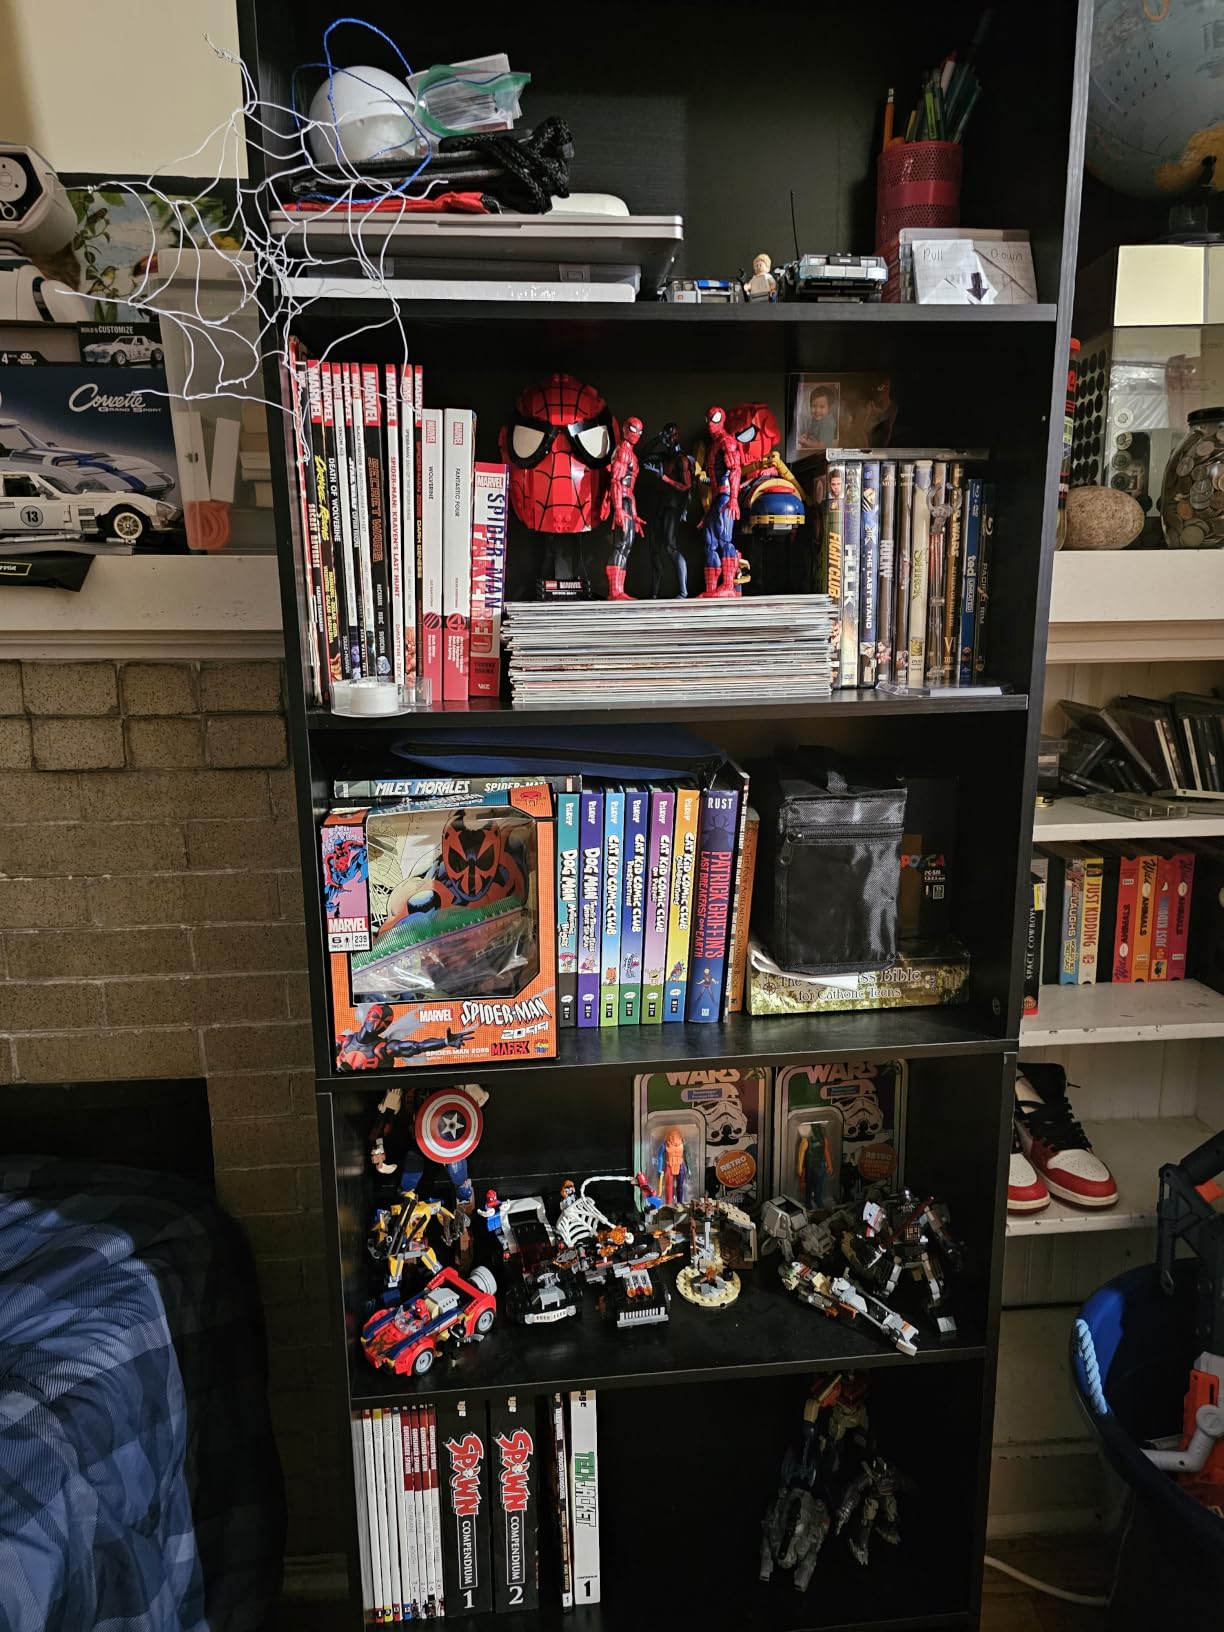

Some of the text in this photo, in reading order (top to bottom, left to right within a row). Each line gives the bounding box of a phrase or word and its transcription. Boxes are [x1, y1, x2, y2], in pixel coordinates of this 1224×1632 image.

[922, 248, 943, 261] Pull
[98, 326, 133, 334] CUSTOMIZE
[69, 383, 146, 412] Corvette
[308, 367, 321, 418] MARVEL
[322, 373, 333, 421] MARVEL
[364, 373, 378, 423] MARVEL
[386, 374, 397, 421] MARVEL
[427, 421, 435, 443] MARVEL
[454, 422, 463, 445] MARVEL
[367, 457, 381, 517] SECRET
[390, 457, 398, 509] SPIDER-MAN:
[476, 476, 504, 489] MARVEL
[328, 458, 340, 542] DEATH OF WOLVERINE
[26, 511, 39, 522] 13
[391, 512, 399, 550] KRAVEN'S
[951, 522, 961, 557] WARS
[471, 523, 495, 594] FAKE
[485, 493, 505, 609] SPIDER-MAN
[880, 540, 894, 578] ROCKY
[828, 532, 841, 598] FIGHT CLUB
[843, 544, 858, 608] HULK
[912, 550, 929, 600] SHREK
[966, 555, 977, 612] ted UNRATED
[979, 563, 988, 602] PACIFIC
[470, 599, 494, 653] RED
[375, 782, 412, 795] MILES
[415, 781, 470, 795] MORALES
[707, 797, 733, 810] RUST
[608, 834, 619, 855] CAT
[634, 834, 645, 855] CAT
[660, 835, 670, 855] CAT
[685, 832, 695, 852] CAT
[561, 849, 578, 874] DOG
[584, 848, 600, 873] DOG
[561, 876, 578, 901] MAN
[583, 875, 599, 900] MAN
[1139, 859, 1157, 936] Wild ANIMALS
[695, 851, 711, 957] LAST BREAKFAST ON EARTH
[705, 851, 732, 958] PATRICK GRIFFIN'S
[1067, 897, 1078, 937] LAUGHS
[1083, 882, 1101, 947] JUST KIDDING
[328, 918, 368, 932] MARVEL
[606, 909, 617, 935] CLUB
[632, 908, 641, 933] CLUB
[656, 909, 665, 933] CLUB
[679, 905, 689, 930] CLUB
[1155, 896, 1169, 947] JUST KIDDI
[734, 930, 744, 968] COMPANION
[1026, 908, 1036, 980] SPACE COWBOYS
[780, 977, 801, 987] The
[881, 968, 921, 983] Bible
[799, 989, 815, 1001] for
[868, 987, 901, 998] Teens
[419, 1009, 452, 1022] MARVEL
[460, 997, 551, 1026] SPIDER-MAN
[501, 1021, 548, 1040] 2099
[426, 1048, 469, 1057] SPIDER-MAN
[491, 1040, 530, 1056] MAFEX
[665, 1068, 740, 1086] WARS
[805, 1063, 877, 1084] WARS
[720, 1155, 746, 1171] RETRO
[865, 1152, 892, 1160] RETRO
[403, 1426, 411, 1456] GUNSLINGER
[493, 1428, 533, 1512] SPAWN
[575, 1452, 597, 1528] TECH JACKET
[442, 1432, 484, 1609] SPAWN COMPENDIUM 1
[509, 1516, 520, 1580] COMPENDIUM
[509, 1586, 523, 1605] 2
[584, 1580, 591, 1597] 1
